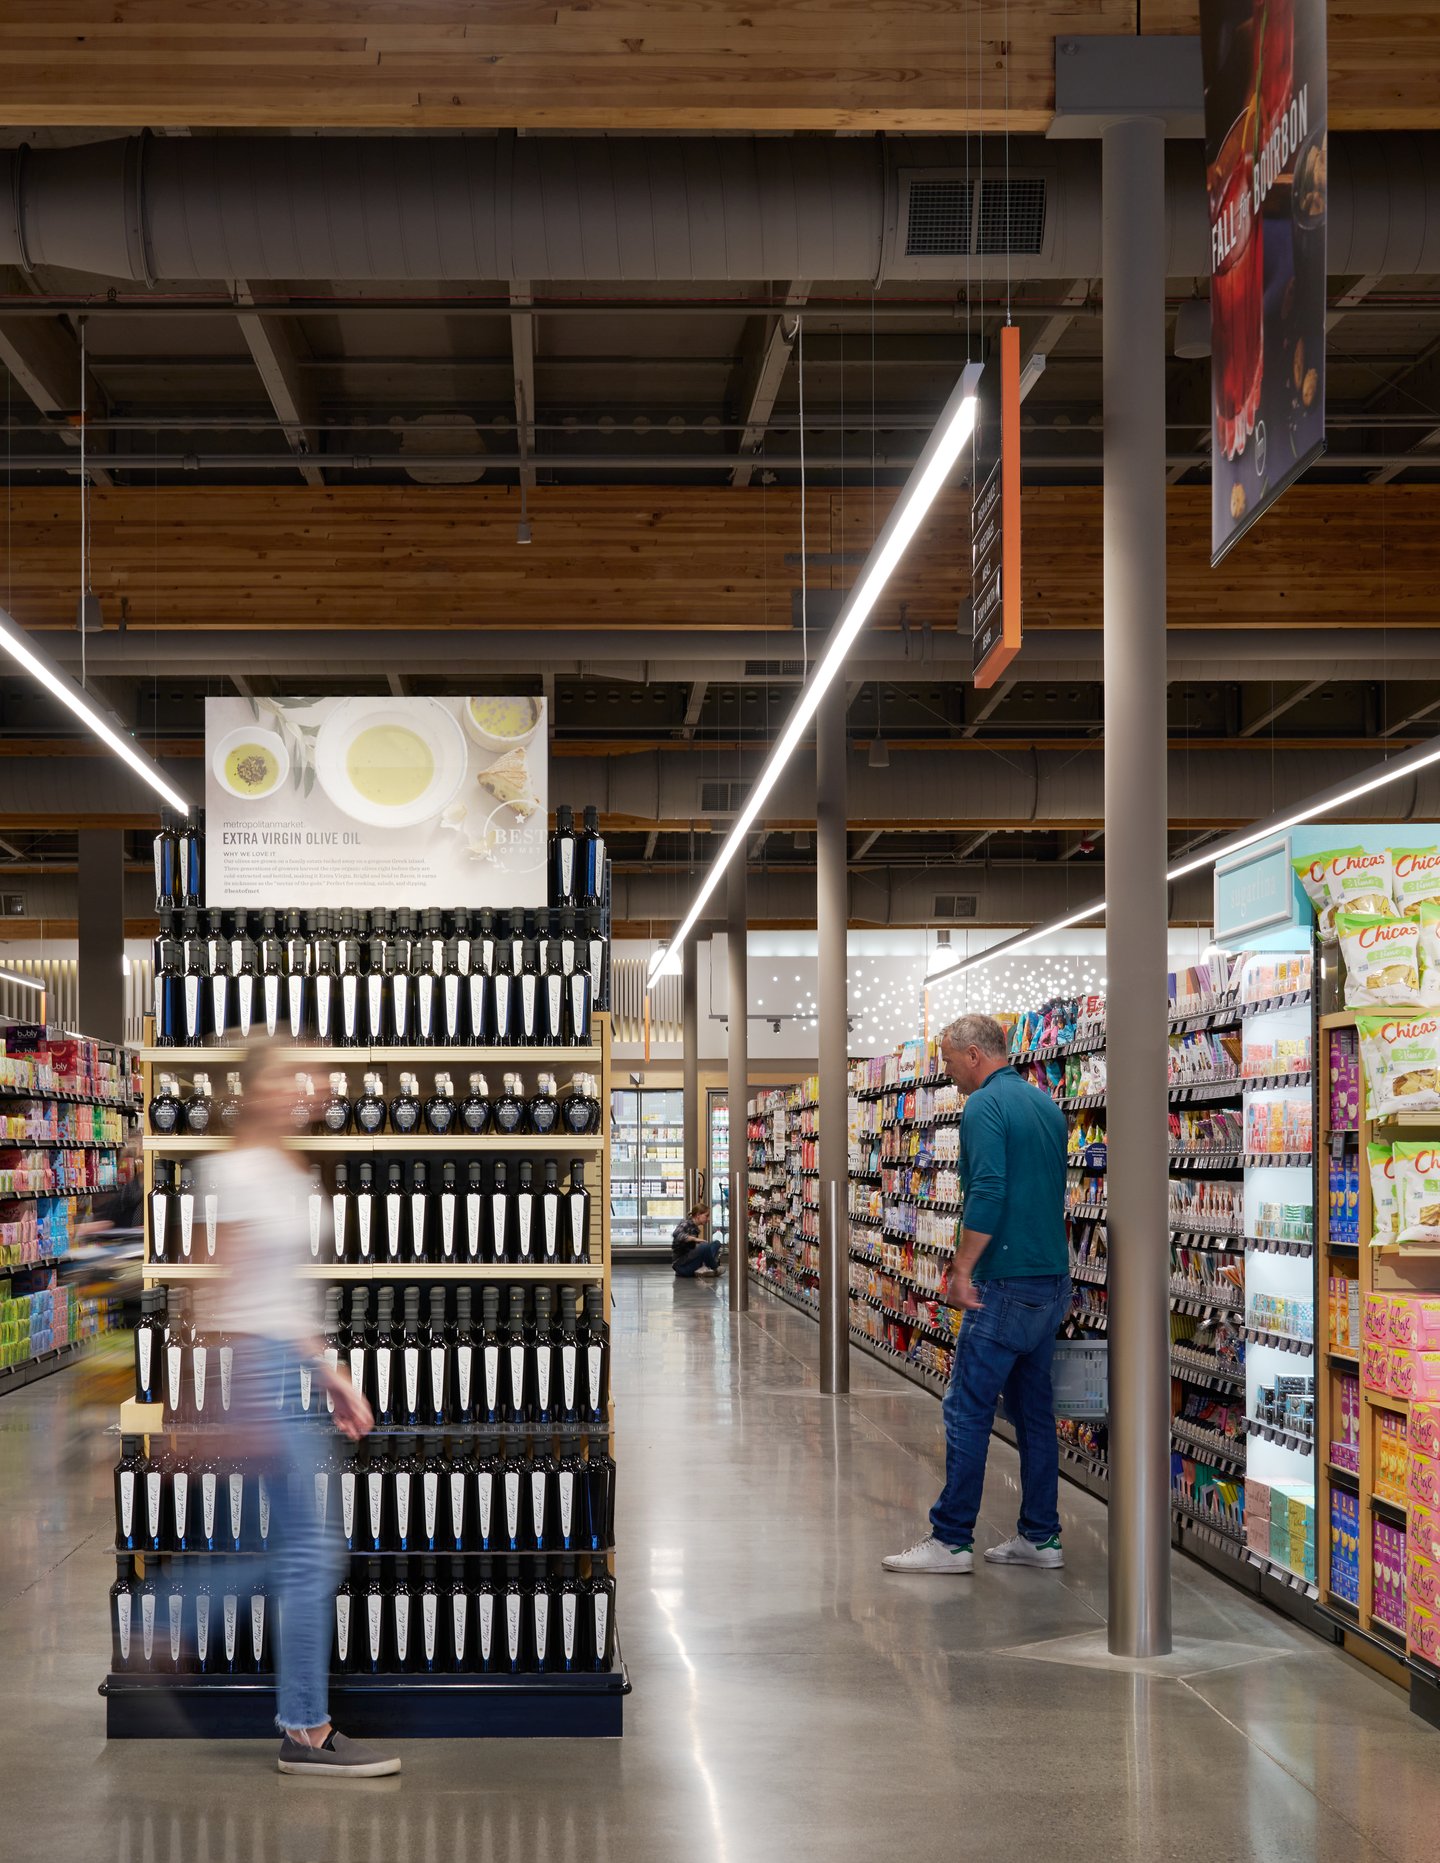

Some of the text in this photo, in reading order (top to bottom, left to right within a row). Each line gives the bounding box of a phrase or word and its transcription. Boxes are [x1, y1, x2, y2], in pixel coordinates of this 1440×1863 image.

[1212, 84, 1309, 273] FALL for BOURBON
[223, 832, 361, 845] EXTRA VIRGIN OLIVE OIL
[495, 828, 547, 844] BEST
[1332, 854, 1385, 876] Chicas
[1395, 853, 1440, 877] Chica
[1359, 925, 1418, 948] Chicas
[1381, 1020, 1437, 1044] Chicas
[51, 1062, 68, 1072] ubly
